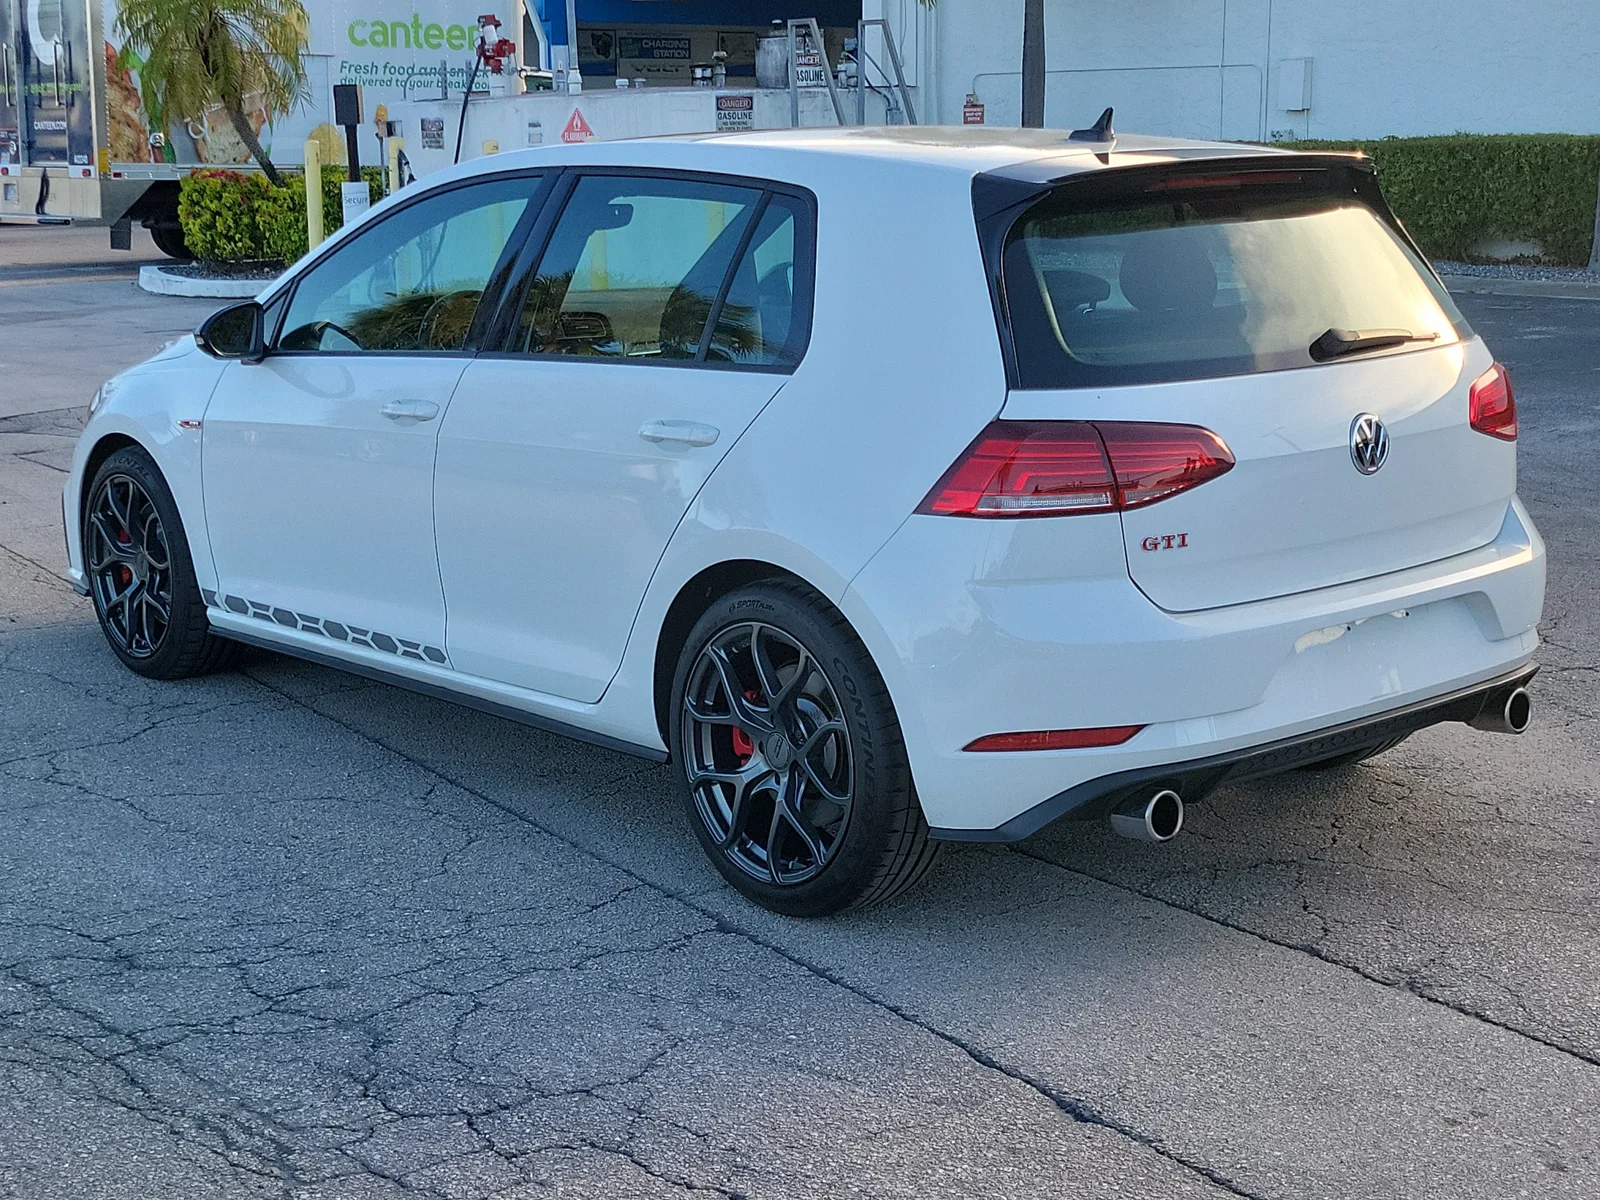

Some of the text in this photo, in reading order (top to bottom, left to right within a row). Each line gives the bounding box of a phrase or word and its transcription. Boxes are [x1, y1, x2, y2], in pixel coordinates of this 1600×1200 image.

[642, 40, 690, 49] CHARGING
[653, 49, 690, 58] STATION
[339, 60, 378, 76] Fresh
[383, 62, 415, 77] food
[796, 70, 825, 82] ASOLINE
[339, 76, 393, 88] delivered
[409, 79, 434, 91] your
[721, 99, 750, 109] DANGER
[717, 112, 753, 121] GASOLINE
[1141, 532, 1188, 552] GTI
